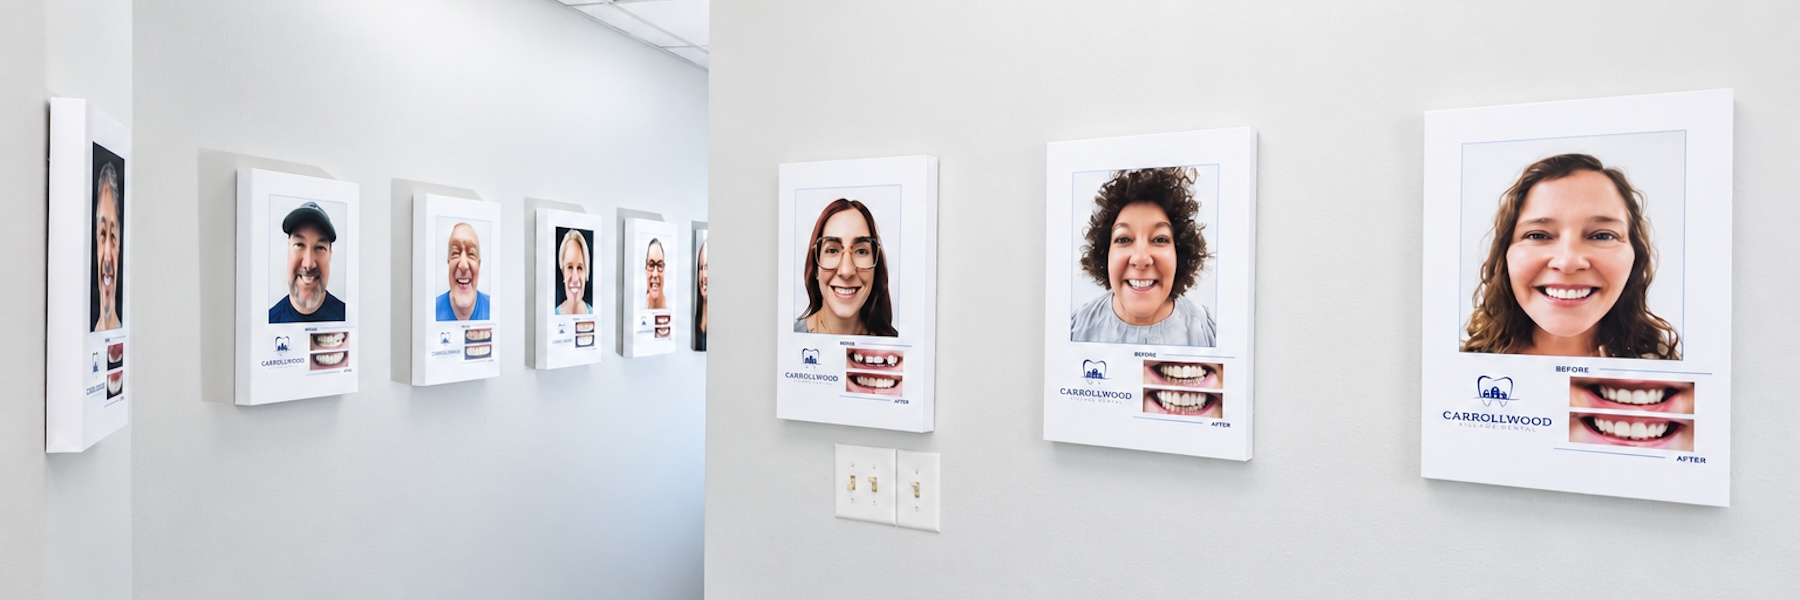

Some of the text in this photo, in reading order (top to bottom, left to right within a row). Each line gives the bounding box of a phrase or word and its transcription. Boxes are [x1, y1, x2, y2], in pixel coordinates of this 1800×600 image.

[1555, 365, 1589, 373] BEFORE
[784, 372, 839, 382] CARROLLWOOD
[1059, 387, 1132, 400] CARROLLWOOD
[1442, 410, 1552, 427] CARROLLWOOD
[1459, 422, 1536, 433] VILLAGE DENTAL
[1676, 455, 1706, 464] AFTER
